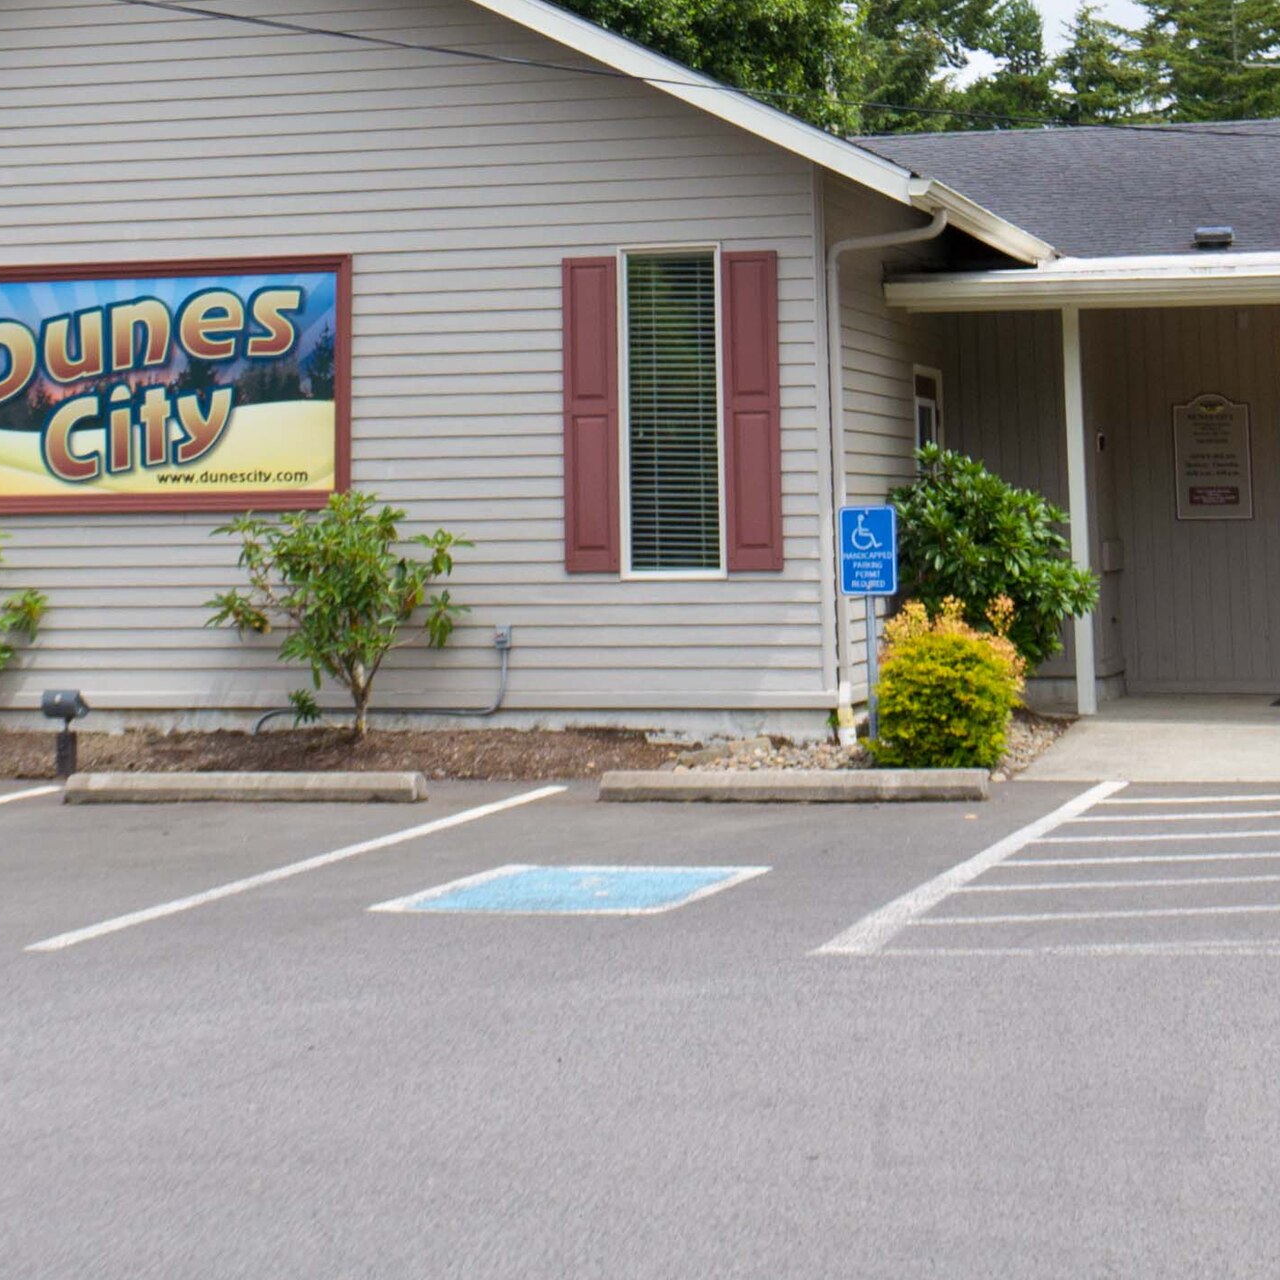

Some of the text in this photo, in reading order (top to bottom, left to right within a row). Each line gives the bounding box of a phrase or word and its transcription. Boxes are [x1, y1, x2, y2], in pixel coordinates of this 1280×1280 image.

[43, 384, 234, 481] City
[157, 470, 308, 484] www.dunescity.com
[853, 561, 883, 569] PARKING
